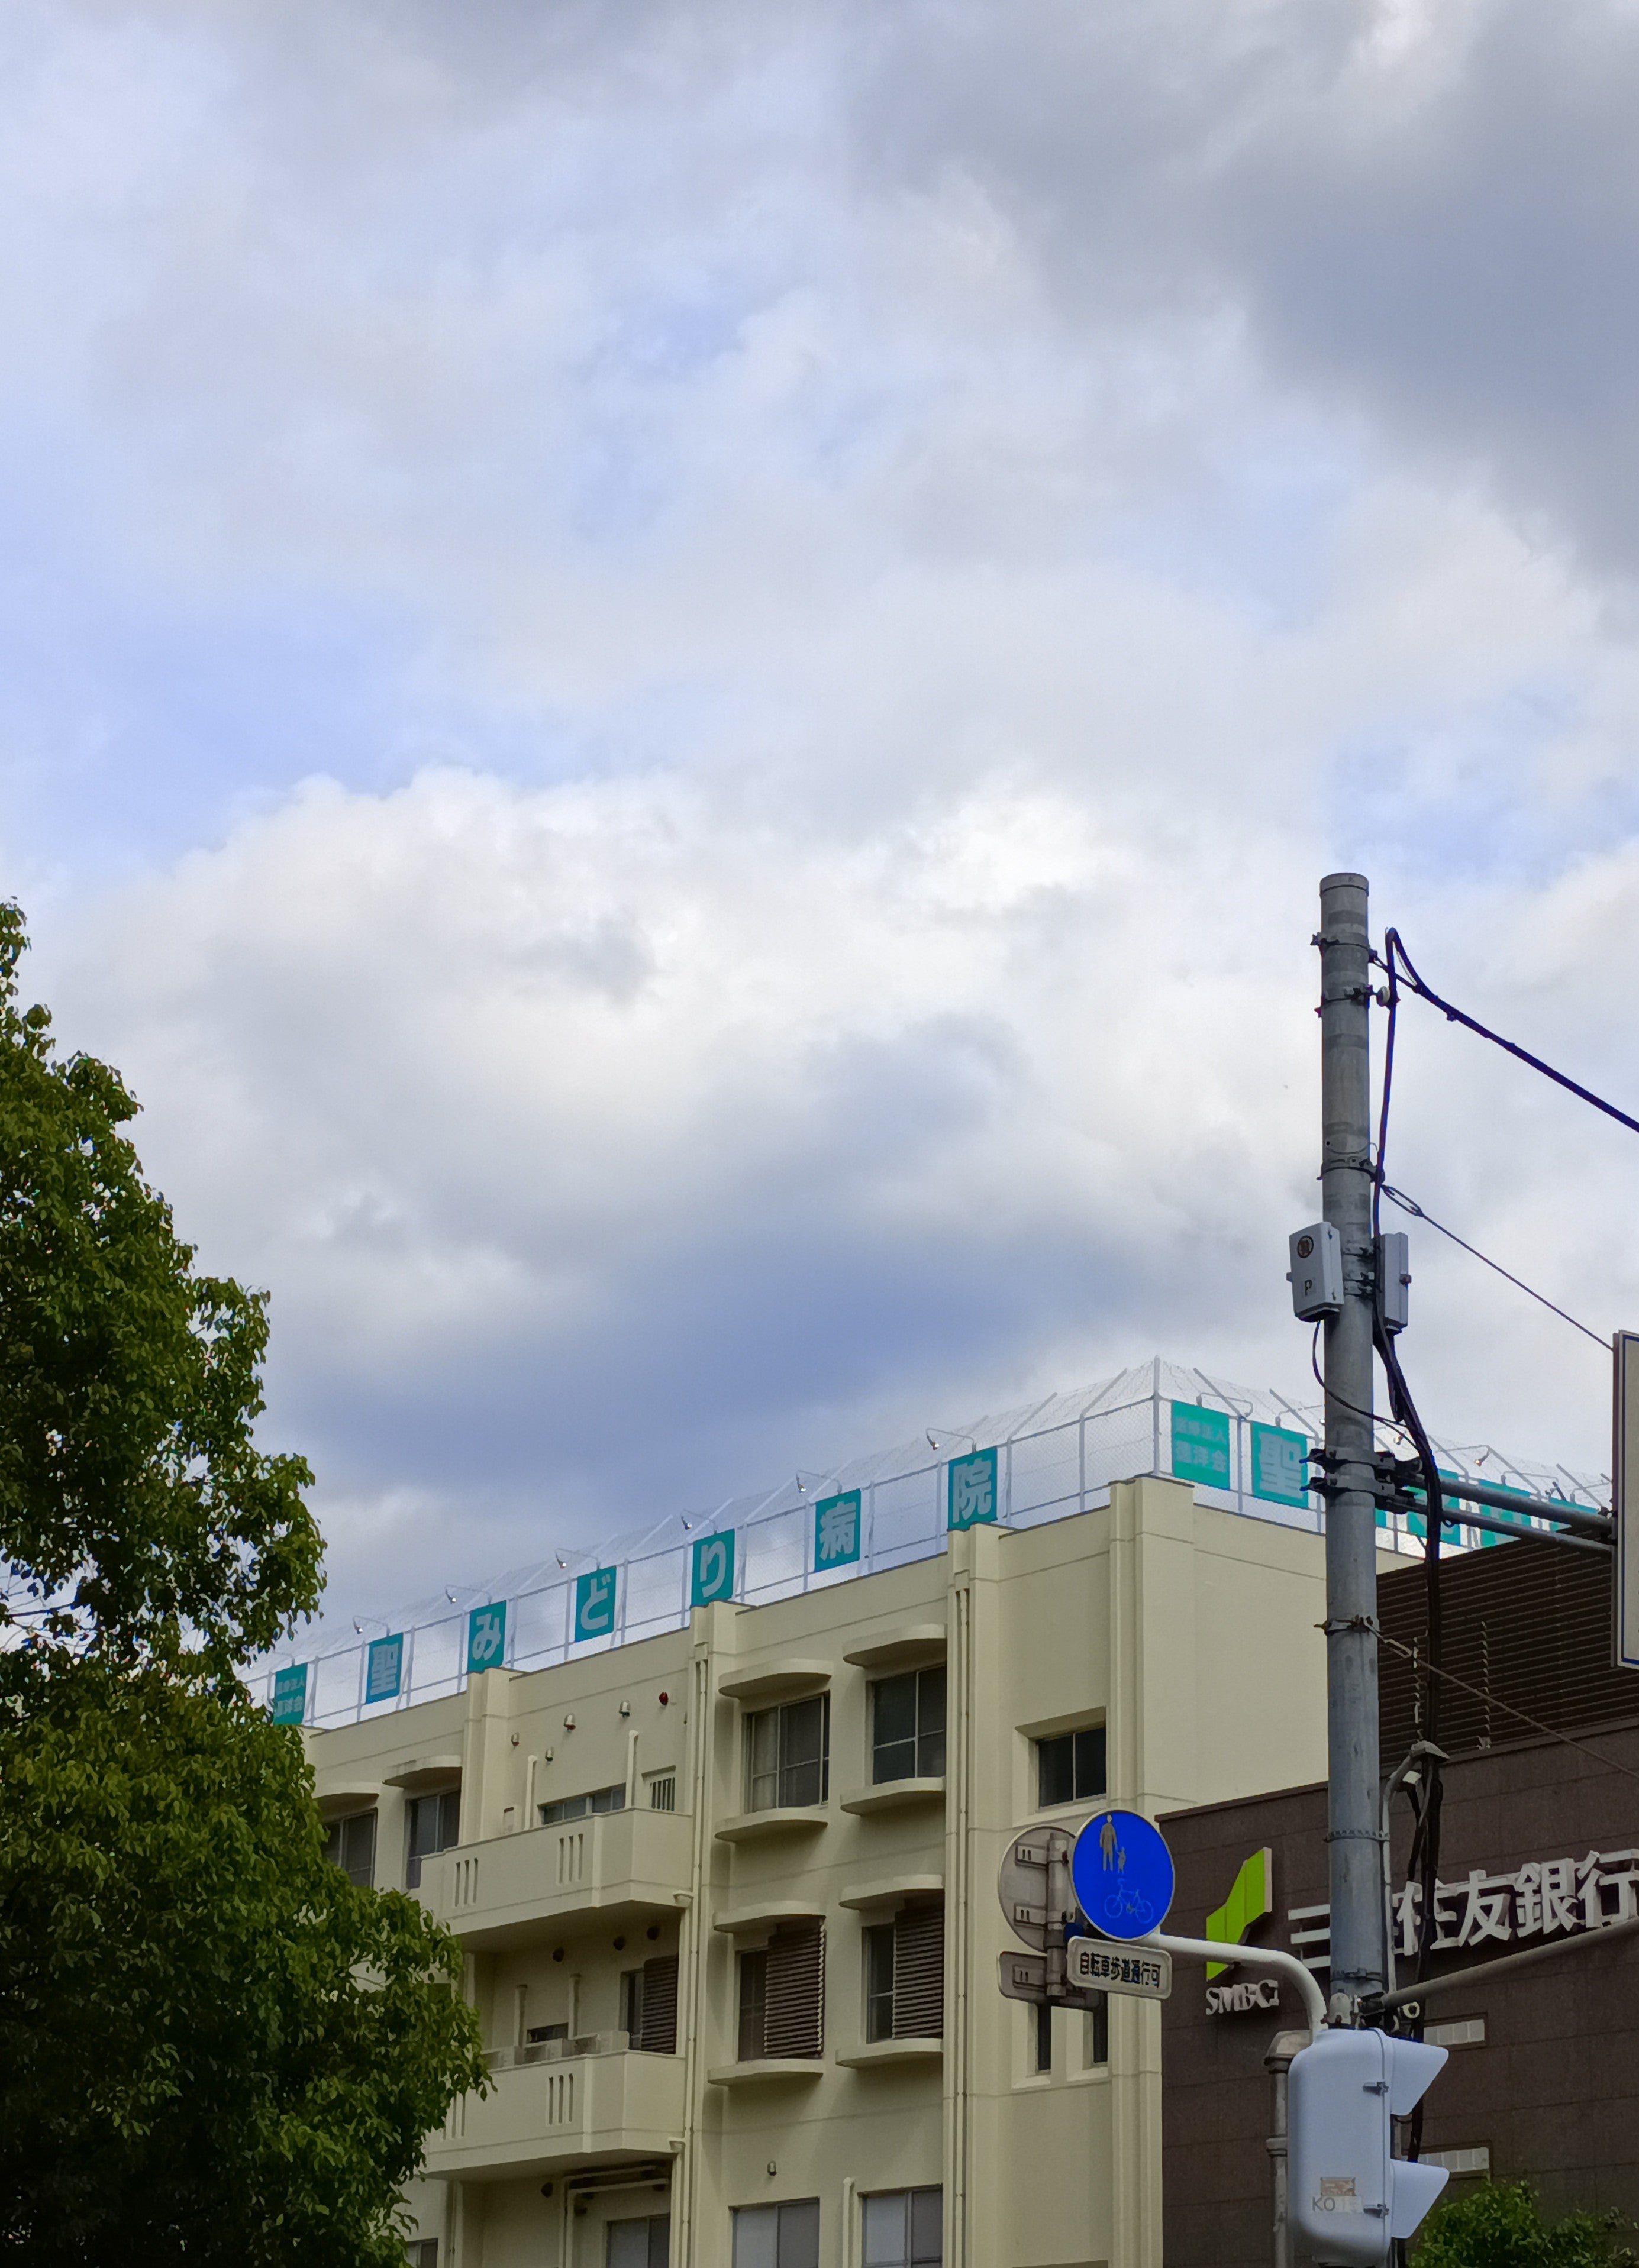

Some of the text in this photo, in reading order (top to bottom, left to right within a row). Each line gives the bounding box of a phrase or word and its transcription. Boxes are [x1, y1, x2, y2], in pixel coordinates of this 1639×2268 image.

[1288, 1848, 1639, 1970] 三住友銀行
[1206, 1979, 1279, 2015] SMBC
